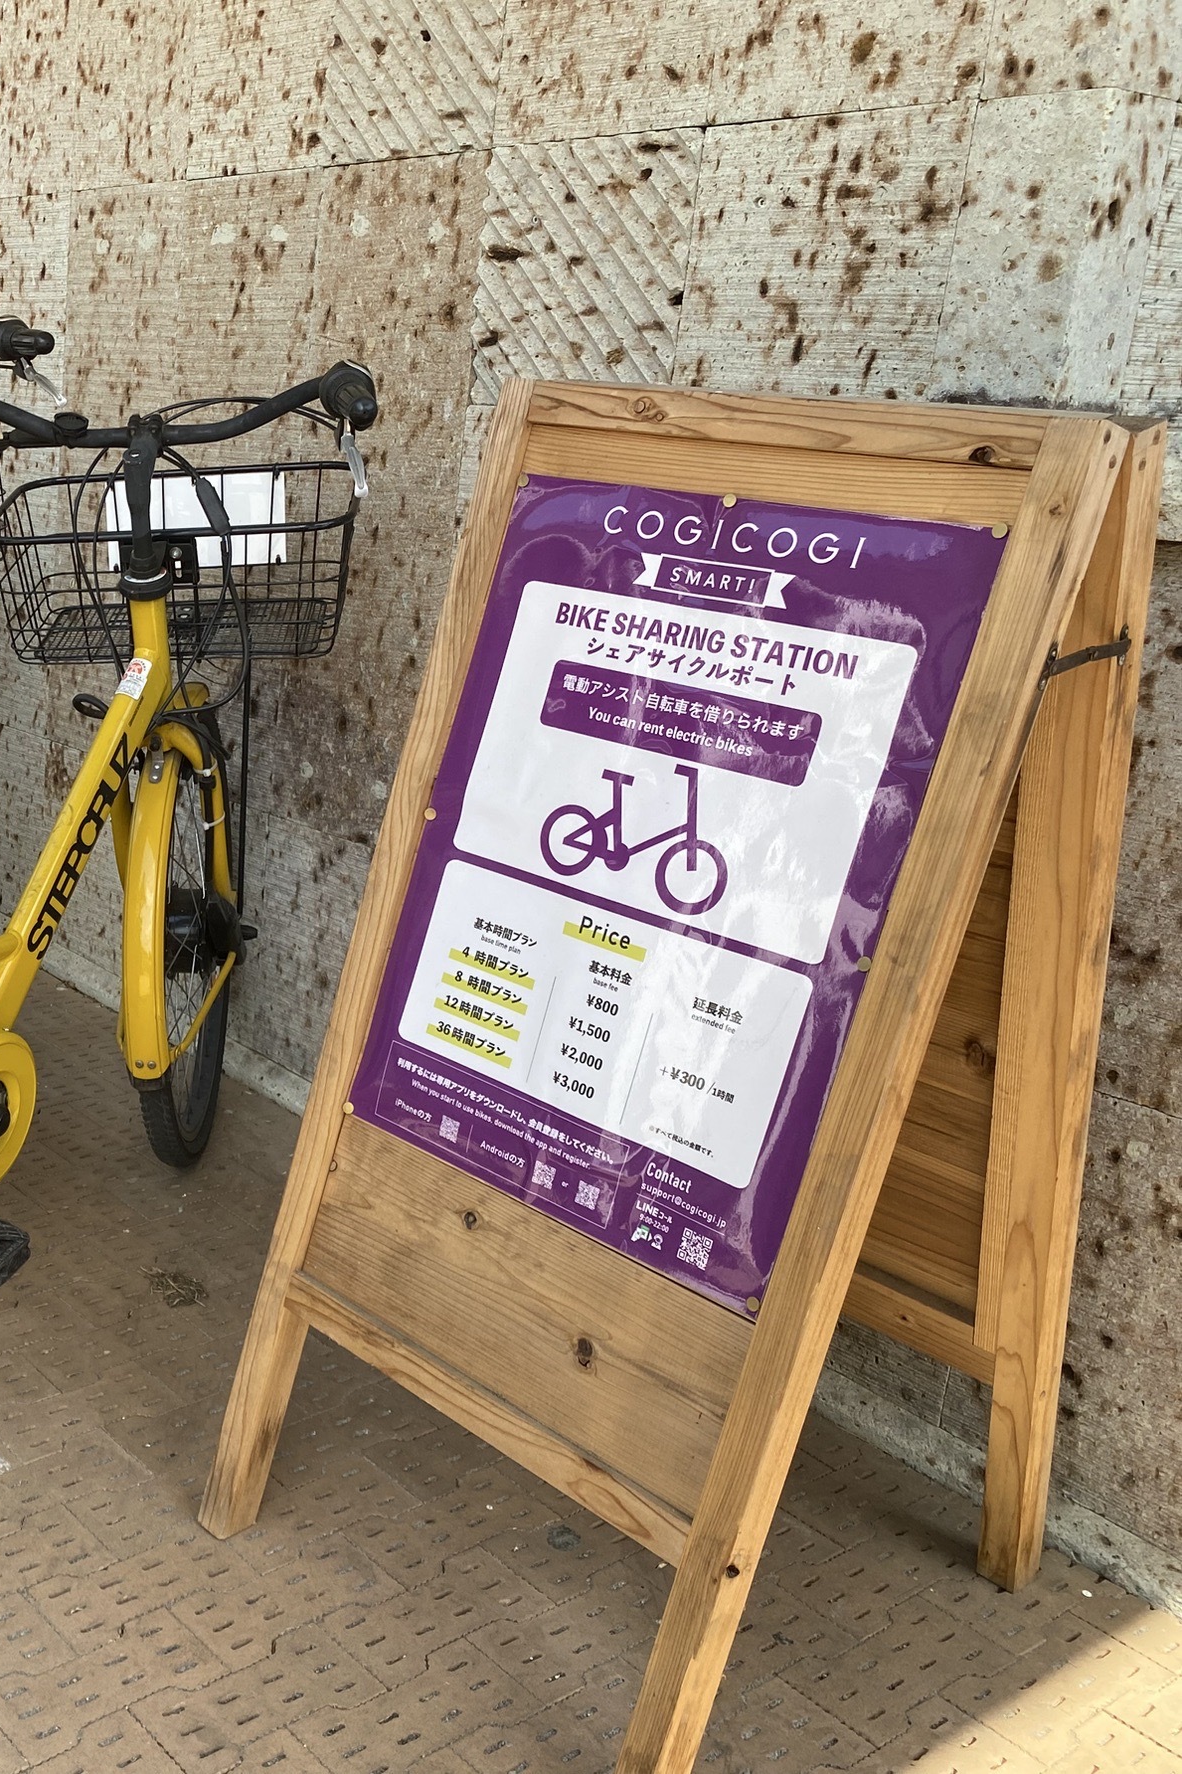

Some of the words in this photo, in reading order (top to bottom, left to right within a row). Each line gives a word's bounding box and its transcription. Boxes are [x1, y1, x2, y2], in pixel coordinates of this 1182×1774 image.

[603, 505, 867, 569] COGICOGI
[670, 567, 756, 594] SMART!
[555, 602, 610, 632] BIKE
[612, 612, 726, 654] SHARING
[730, 633, 859, 680] STATION
[586, 637, 796, 696] シェアサイクルポート
[562, 673, 804, 740] 電動アシスト自転車を借りられます
[588, 706, 610, 724] You
[612, 714, 637, 730] can
[637, 720, 665, 736] rent
[666, 725, 713, 748] electric
[714, 737, 753, 757] bikes
[473, 917, 538, 948] 基本時間プラン
[480, 934, 494, 946] base
[508, 943, 521, 955] plan
[578, 915, 631, 950] Price
[588, 960, 633, 987] 基本料金
[592, 977, 608, 990] base
[608, 982, 618, 993] fee
[586, 994, 619, 1016] ¥800
[692, 997, 743, 1025] 延長料金
[569, 1016, 611, 1043] ¥1,500
[691, 1013, 725, 1031] extended
[725, 1022, 736, 1034] fee
[560, 1043, 603, 1071] ¥2,000
[553, 1071, 595, 1099] ¥3,000
[394, 1098, 432, 1123] iPhoneの方
[411, 1079, 428, 1093] When
[428, 1088, 439, 1098] you
[440, 1093, 455, 1105] start
[462, 1104, 474, 1115] use
[494, 1117, 525, 1138] download
[524, 1132, 535, 1144] the
[535, 1140, 548, 1151] app
[548, 1145, 562, 1156] and
[479, 1140, 526, 1168] Androidの方
[646, 1162, 692, 1194] Contact
[640, 1182, 727, 1229] support@cogicogi.jp
[639, 1213, 670, 1233] 9:00-22:00
